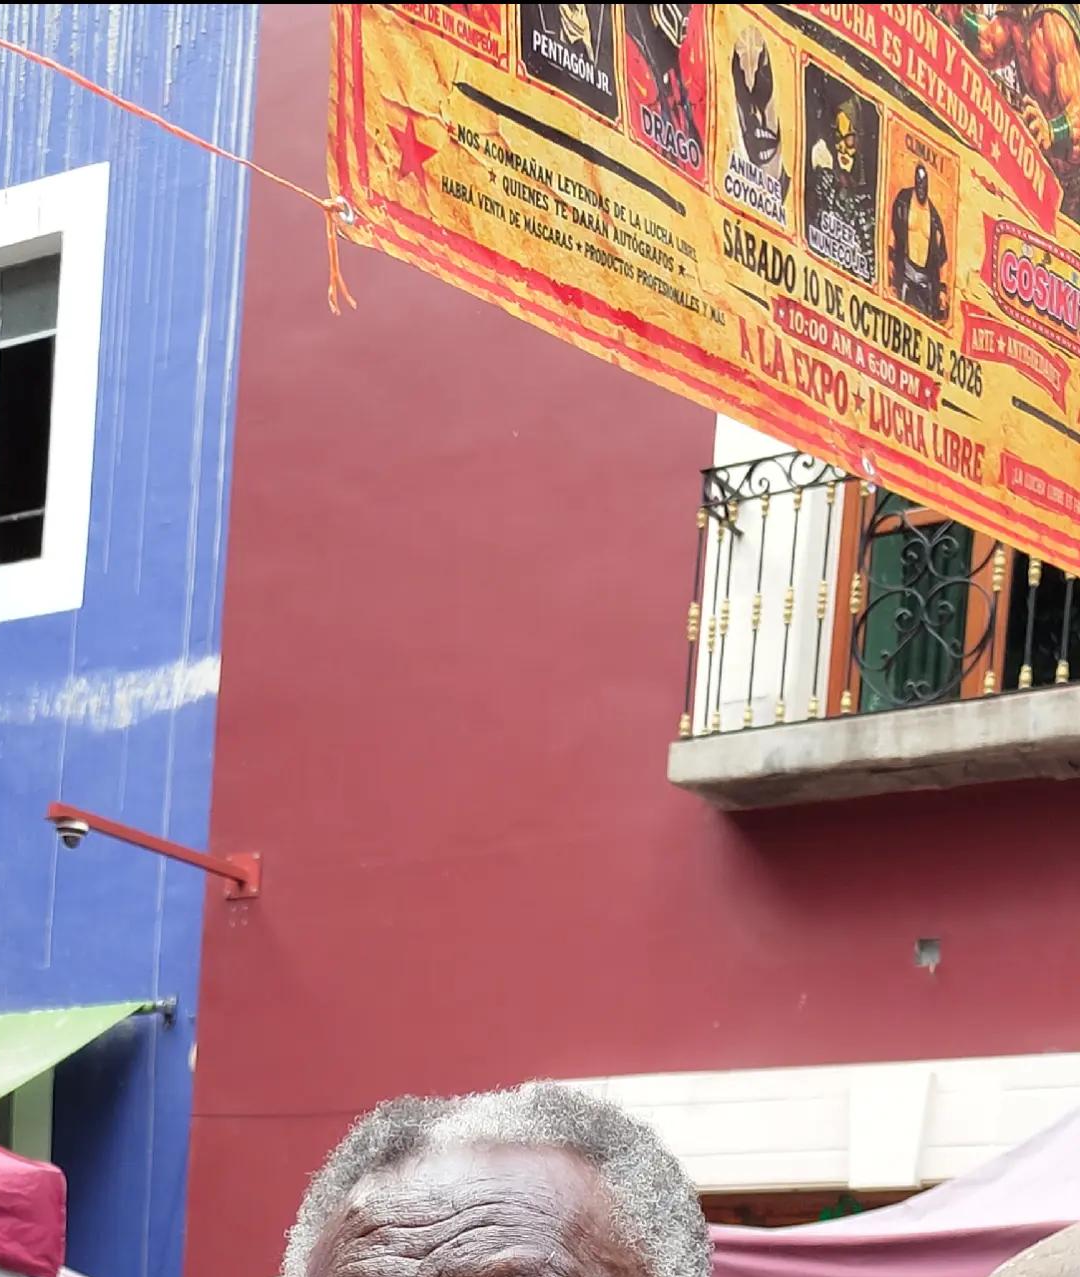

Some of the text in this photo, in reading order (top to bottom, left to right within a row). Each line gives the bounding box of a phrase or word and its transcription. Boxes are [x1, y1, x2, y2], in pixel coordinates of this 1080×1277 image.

[532, 30, 595, 84] PENTAGÓN
[882, 25, 902, 68] ES
[907, 47, 985, 149] LEYENDA!
[944, 38, 957, 75] Y
[457, 123, 481, 151] NOS
[484, 138, 553, 187] ACOMPAÑAN
[557, 173, 610, 214] LEYENDAS
[614, 201, 626, 222] DE
[629, 209, 641, 231] LA
[644, 217, 674, 248] LUCHA
[642, 105, 701, 168] DRAGO
[441, 174, 476, 207] HABRÁ
[478, 191, 507, 223] VENTA
[509, 208, 521, 229] DE
[524, 215, 574, 251] MÁSCARAS
[584, 241, 634, 280] PRODUCTOS
[502, 175, 674, 273] QUIENES TE DARÁN AUTÓGRAFOS
[723, 218, 983, 398] SÁBADO 10 DE OCTUBRE DE 2026
[788, 306, 920, 398] 10:00 AM A 6:00 PM
[738, 315, 986, 485] A LA EXPO LUCHA LIBRE
